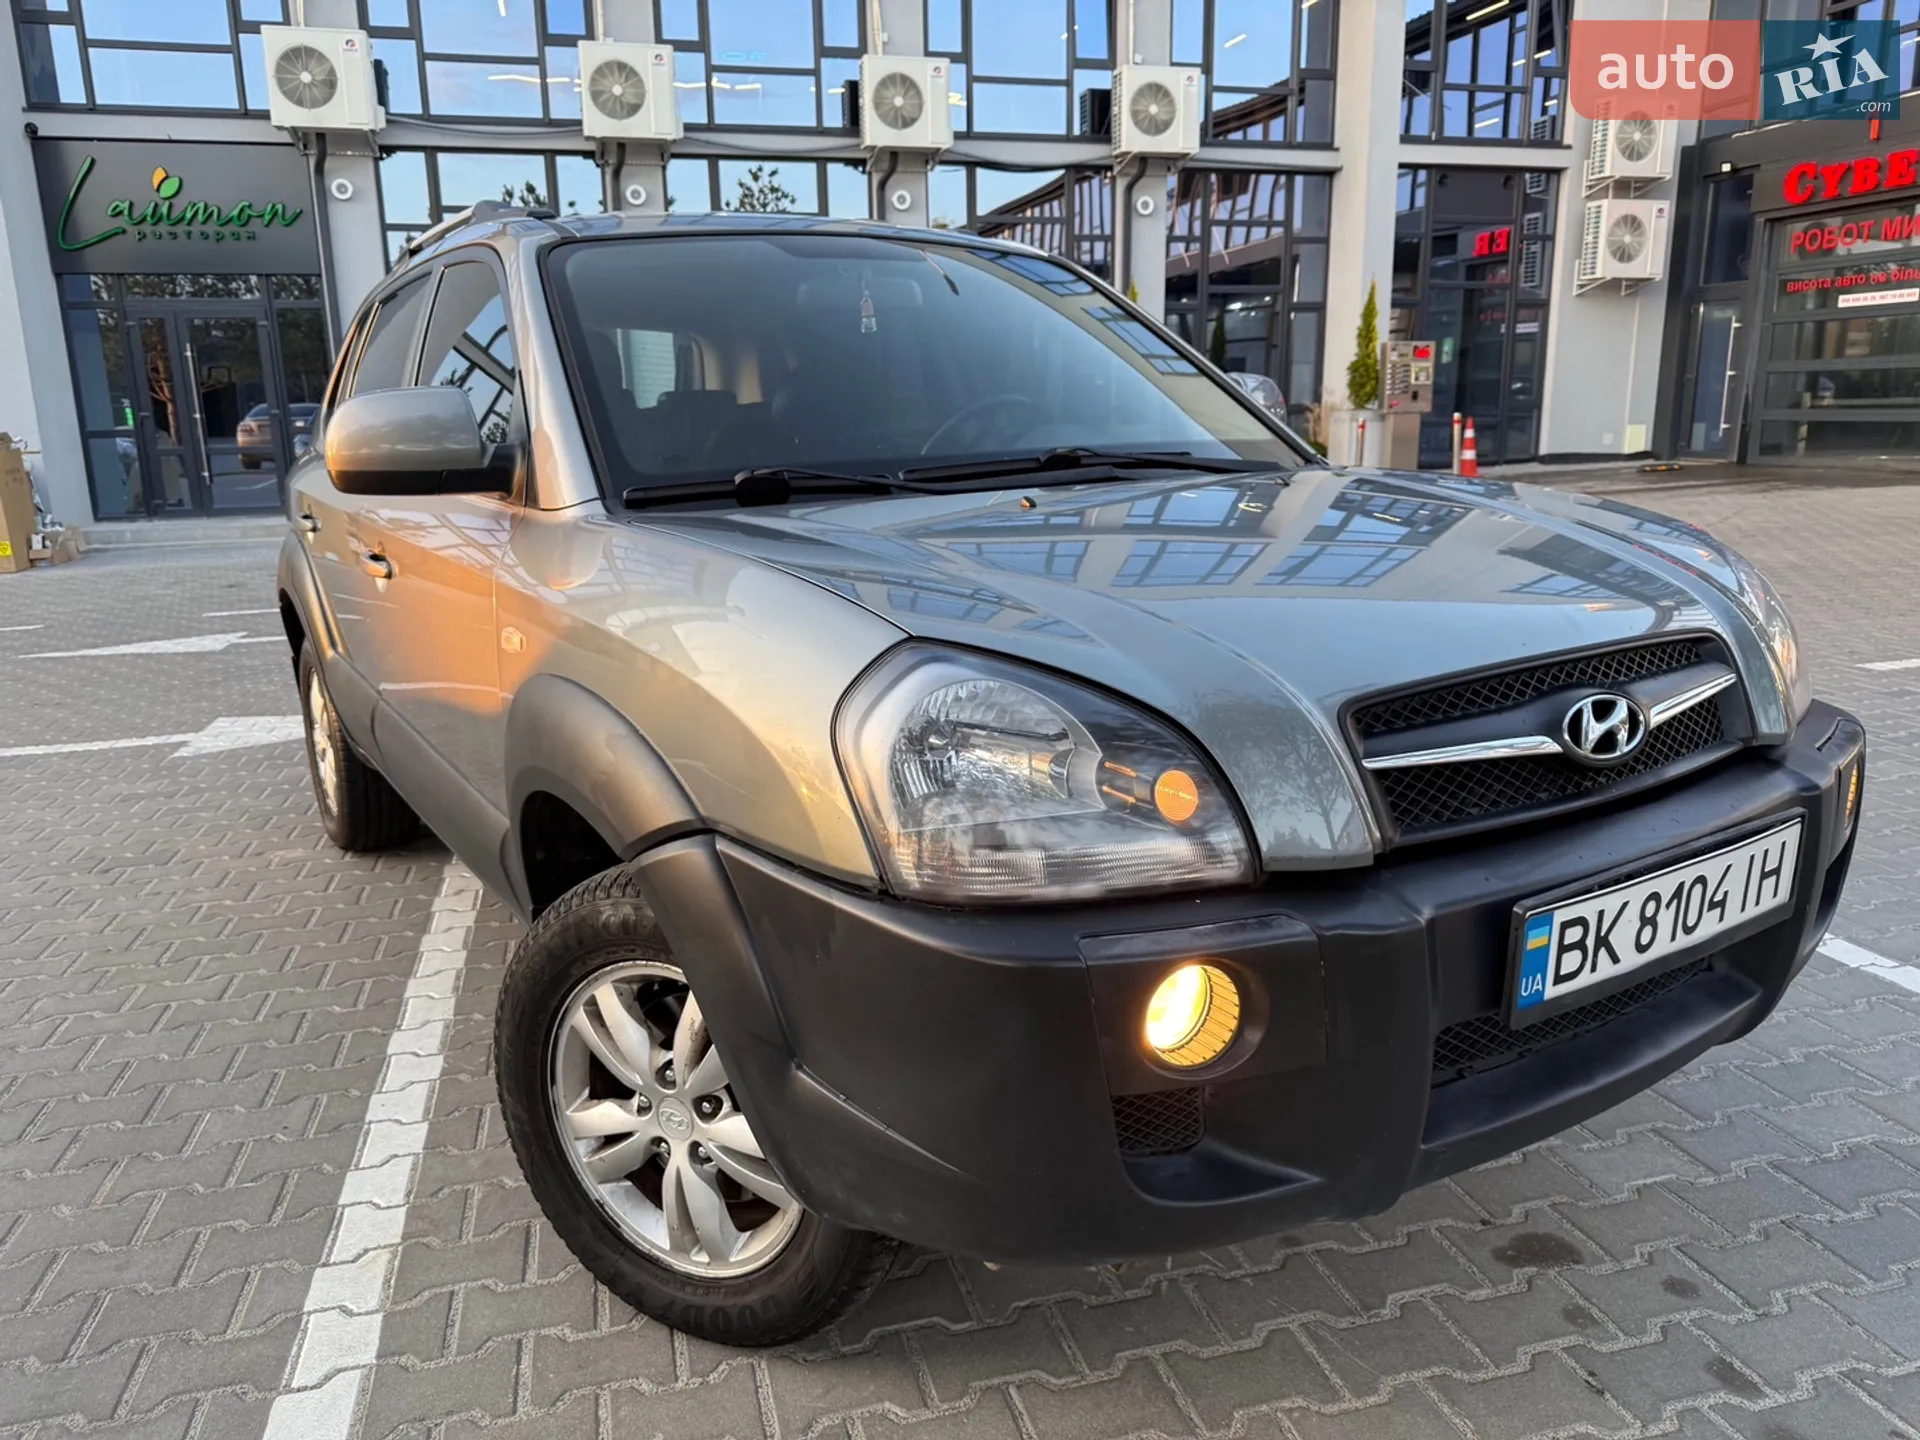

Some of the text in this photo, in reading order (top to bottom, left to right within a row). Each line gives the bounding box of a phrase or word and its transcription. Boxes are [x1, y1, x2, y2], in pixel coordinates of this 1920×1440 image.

[1783, 148, 1919, 206] CYBE
[1790, 220, 1876, 254] РОБОТ
[1786, 278, 1832, 294] висота
[1834, 274, 1867, 288] авто
[1552, 840, 1787, 987] BK 8104 IH
[1520, 974, 1543, 997] UA
